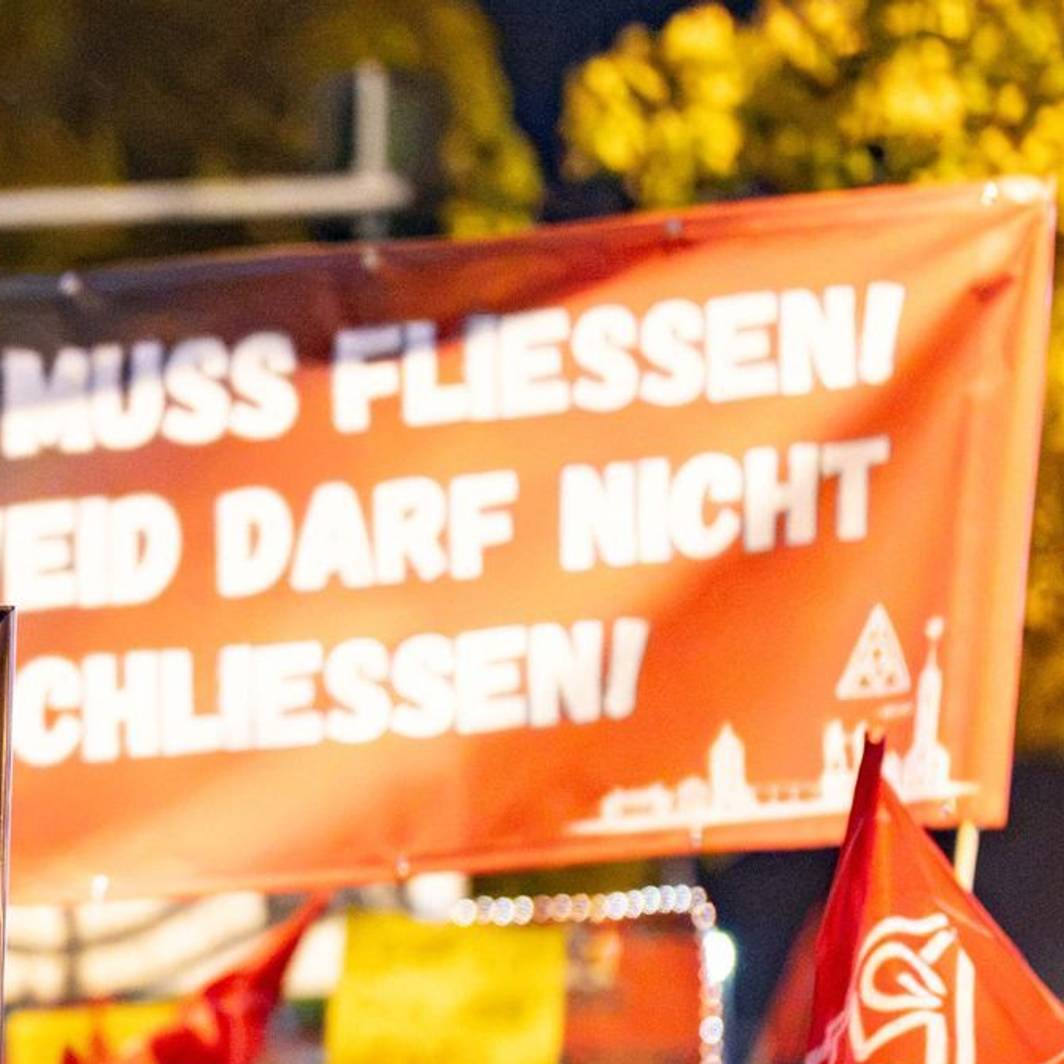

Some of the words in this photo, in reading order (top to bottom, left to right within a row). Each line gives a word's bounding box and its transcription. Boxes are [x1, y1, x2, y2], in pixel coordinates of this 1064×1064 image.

[0, 332, 299, 460] MUSS
[332, 281, 906, 435] FLIESSEN!
[214, 469, 520, 598] DARF
[557, 437, 891, 572] NICHT
[12, 618, 651, 766] CHLIESSEN!
